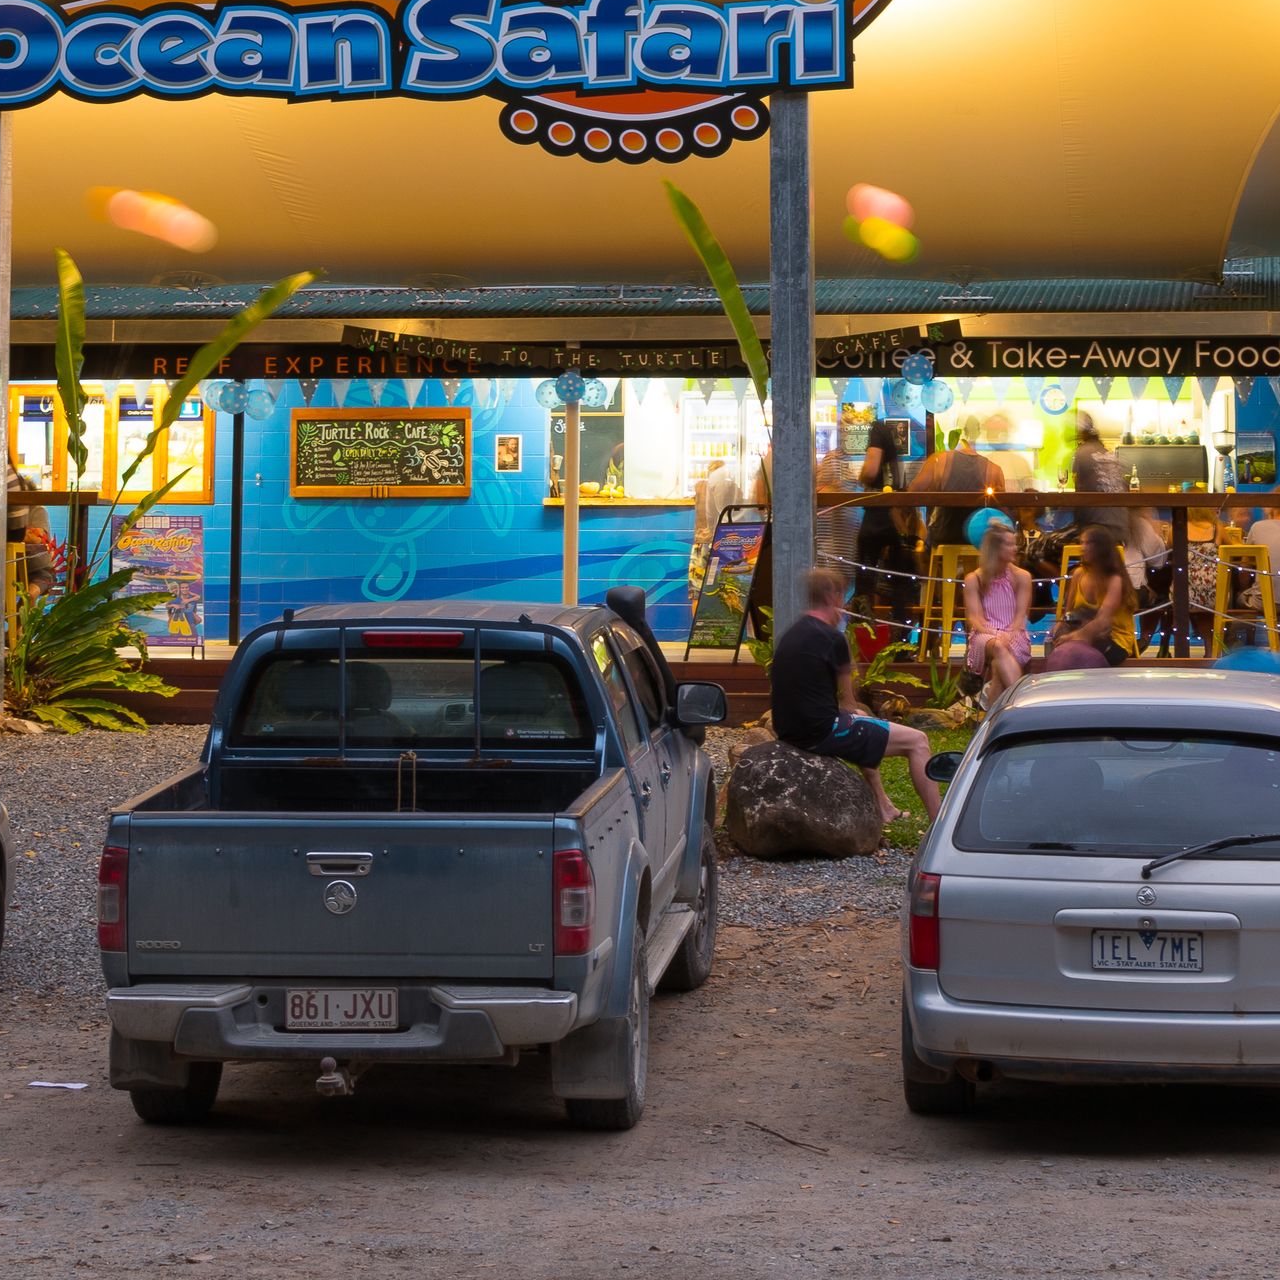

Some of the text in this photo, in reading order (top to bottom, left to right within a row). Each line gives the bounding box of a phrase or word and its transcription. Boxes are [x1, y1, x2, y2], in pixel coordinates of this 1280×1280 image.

[360, 335, 719, 367] WELCOME TO THE TURTLE
[835, 334, 901, 354] CAFE
[154, 356, 481, 374] REF EXPERIENCE
[950, 340, 976, 368] &
[987, 340, 1182, 374] Take-Away
[317, 422, 428, 440] TURTLE ROCK CAFE
[135, 940, 182, 949] RODEO
[529, 943, 545, 951] LT
[1099, 935, 1198, 962] 1EL 7ME
